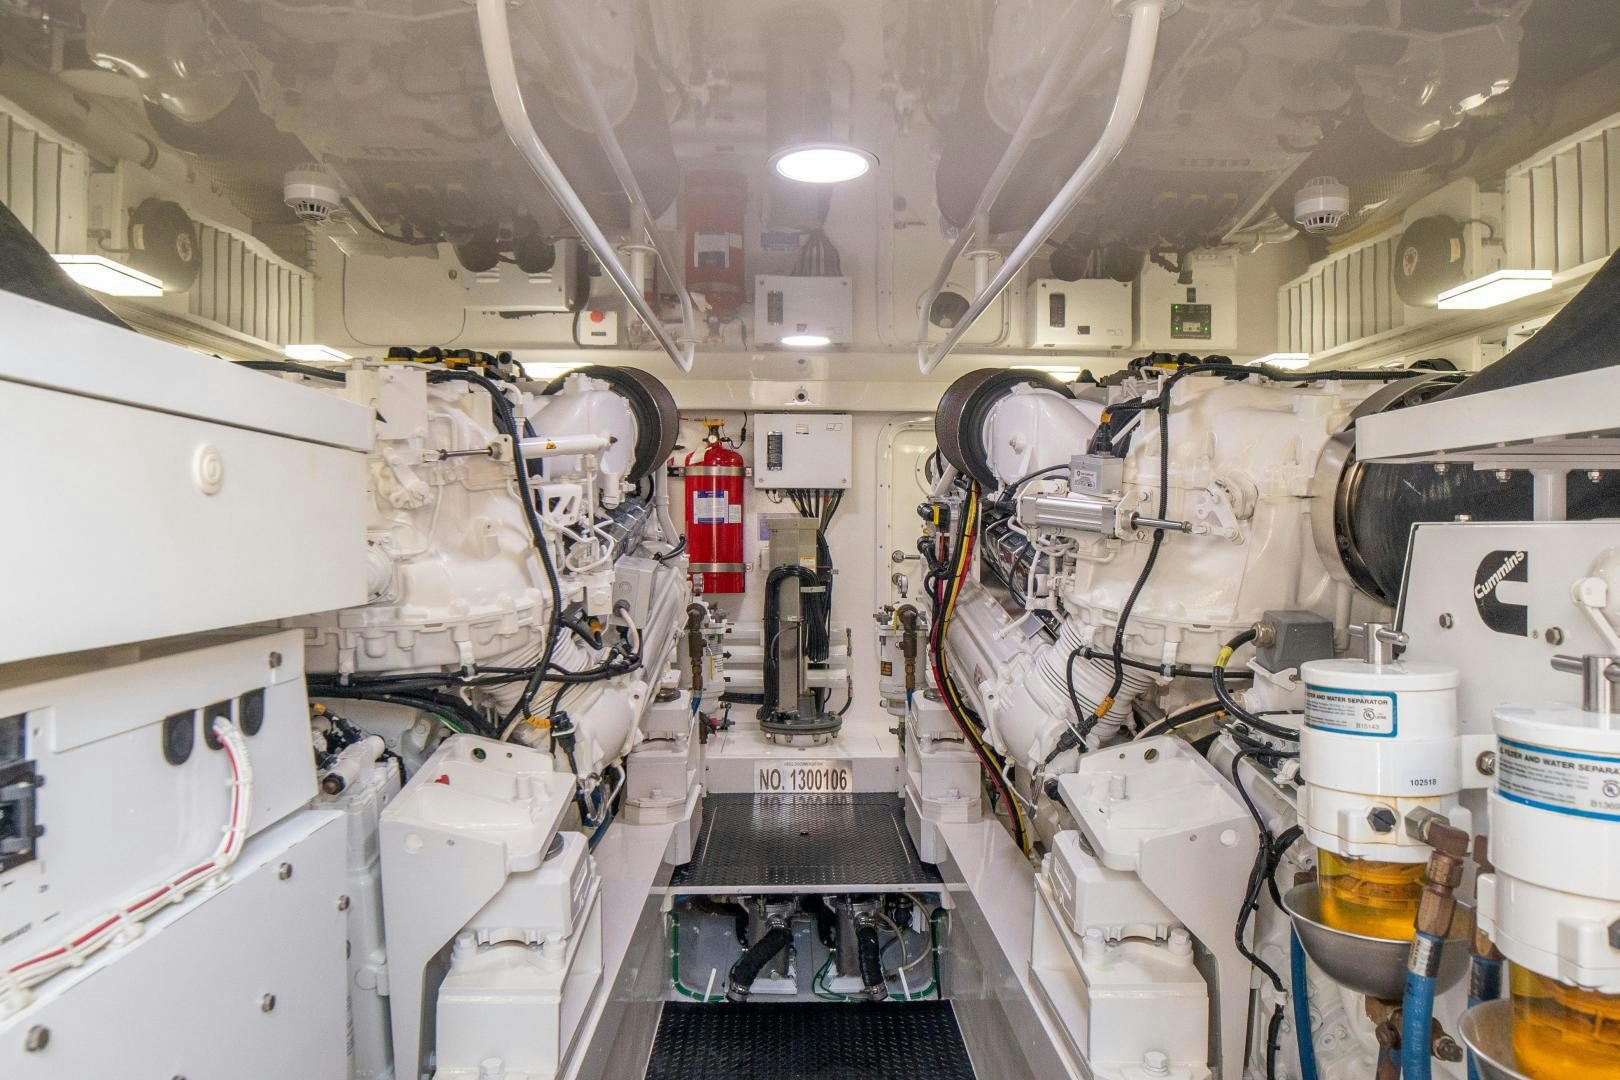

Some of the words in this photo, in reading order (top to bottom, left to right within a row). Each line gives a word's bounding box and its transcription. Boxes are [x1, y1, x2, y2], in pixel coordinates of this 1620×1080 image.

[1474, 549, 1525, 599] Cummins
[1347, 697, 1388, 705] SEPARATOR
[1504, 748, 1522, 759] FILTER
[1524, 754, 1541, 763] AND
[1543, 758, 1576, 769] WATER
[1578, 764, 1620, 774] SEPARA
[759, 768, 785, 791] NO.
[790, 768, 848, 791] 1300106
